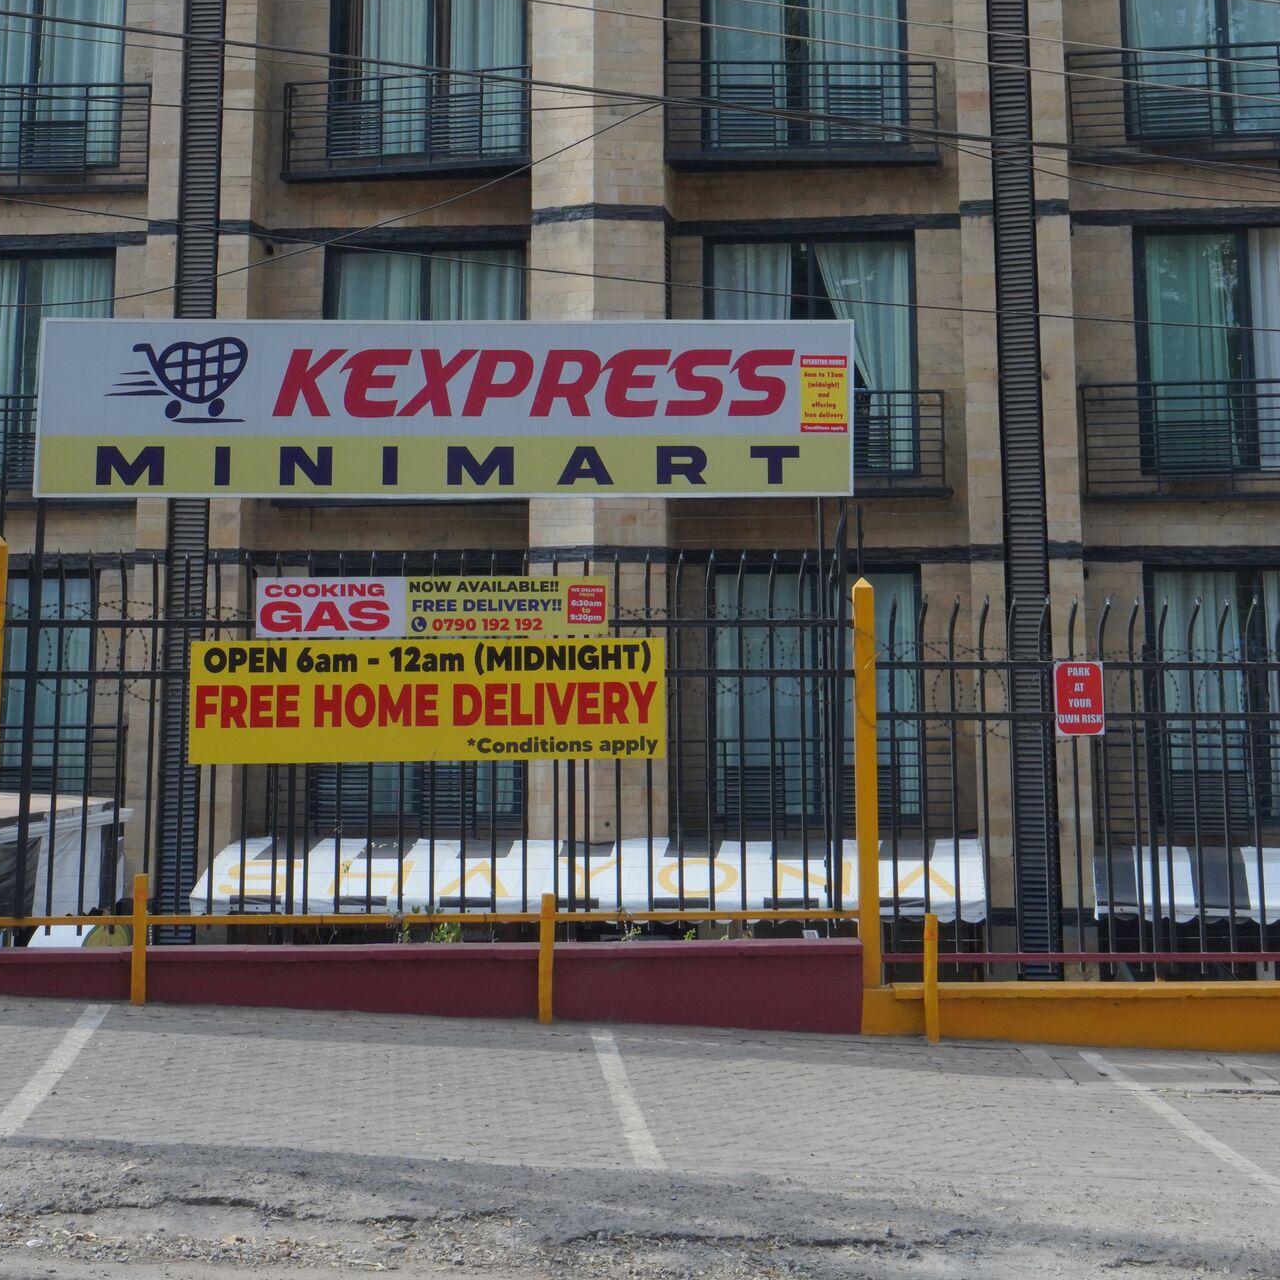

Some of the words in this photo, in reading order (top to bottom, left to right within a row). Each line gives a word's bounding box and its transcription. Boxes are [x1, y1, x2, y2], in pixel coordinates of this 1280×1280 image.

[272, 348, 795, 419] KEXPRESS
[808, 381, 840, 389] (midnight)
[818, 412, 844, 420] delivery
[95, 445, 800, 486] MINIMART
[264, 583, 385, 598] COOKING
[409, 581, 452, 593] NOW
[456, 580, 559, 593] AVAILABLE!!
[412, 599, 457, 612] FREE
[462, 599, 562, 612] DELIVERY!!
[260, 599, 391, 632] GAS
[570, 614, 602, 622] 9:30pm
[432, 618, 477, 632] 0790
[482, 618, 510, 631] 192
[516, 618, 543, 631] 192
[203, 647, 287, 673] OPEN
[297, 646, 358, 673] 6am
[389, 647, 465, 673] 12am
[474, 644, 652, 676] (MIDNIGHT)
[1067, 667, 1090, 677] PARK
[1074, 683, 1085, 692] AT
[195, 684, 300, 729] FREE
[313, 683, 439, 728] HOME
[452, 680, 658, 727] DELIVERY
[1068, 698, 1092, 708] YOUR
[1059, 714, 1080, 724] OWN
[1081, 714, 1102, 724] RISK
[599, 735, 659, 757] apply
